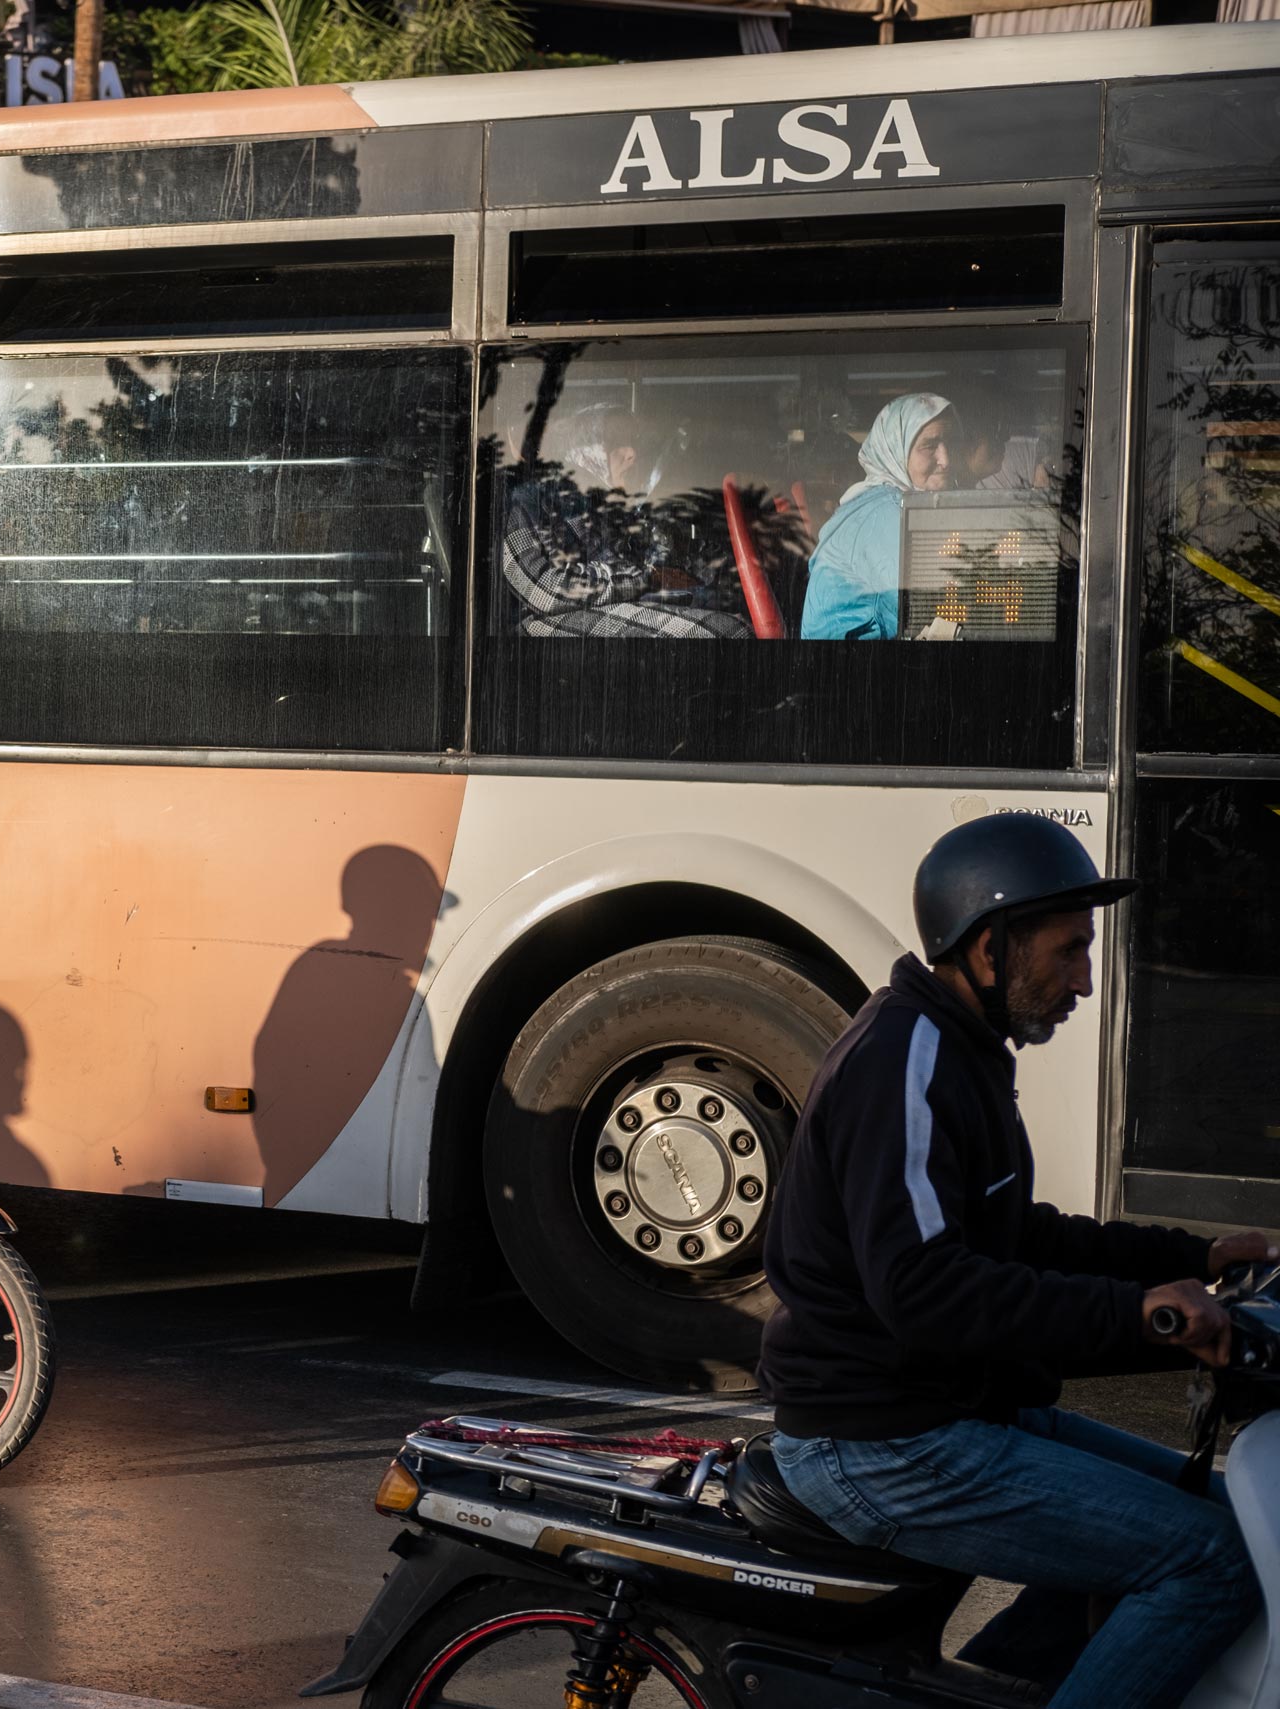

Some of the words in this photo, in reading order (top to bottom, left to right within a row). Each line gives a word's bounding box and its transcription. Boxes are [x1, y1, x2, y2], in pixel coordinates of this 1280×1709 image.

[600, 98, 940, 194] ALSA
[656, 1133, 702, 1216] SCANIA
[456, 1510, 493, 1529] C90
[733, 1570, 816, 1596] DOCKER
